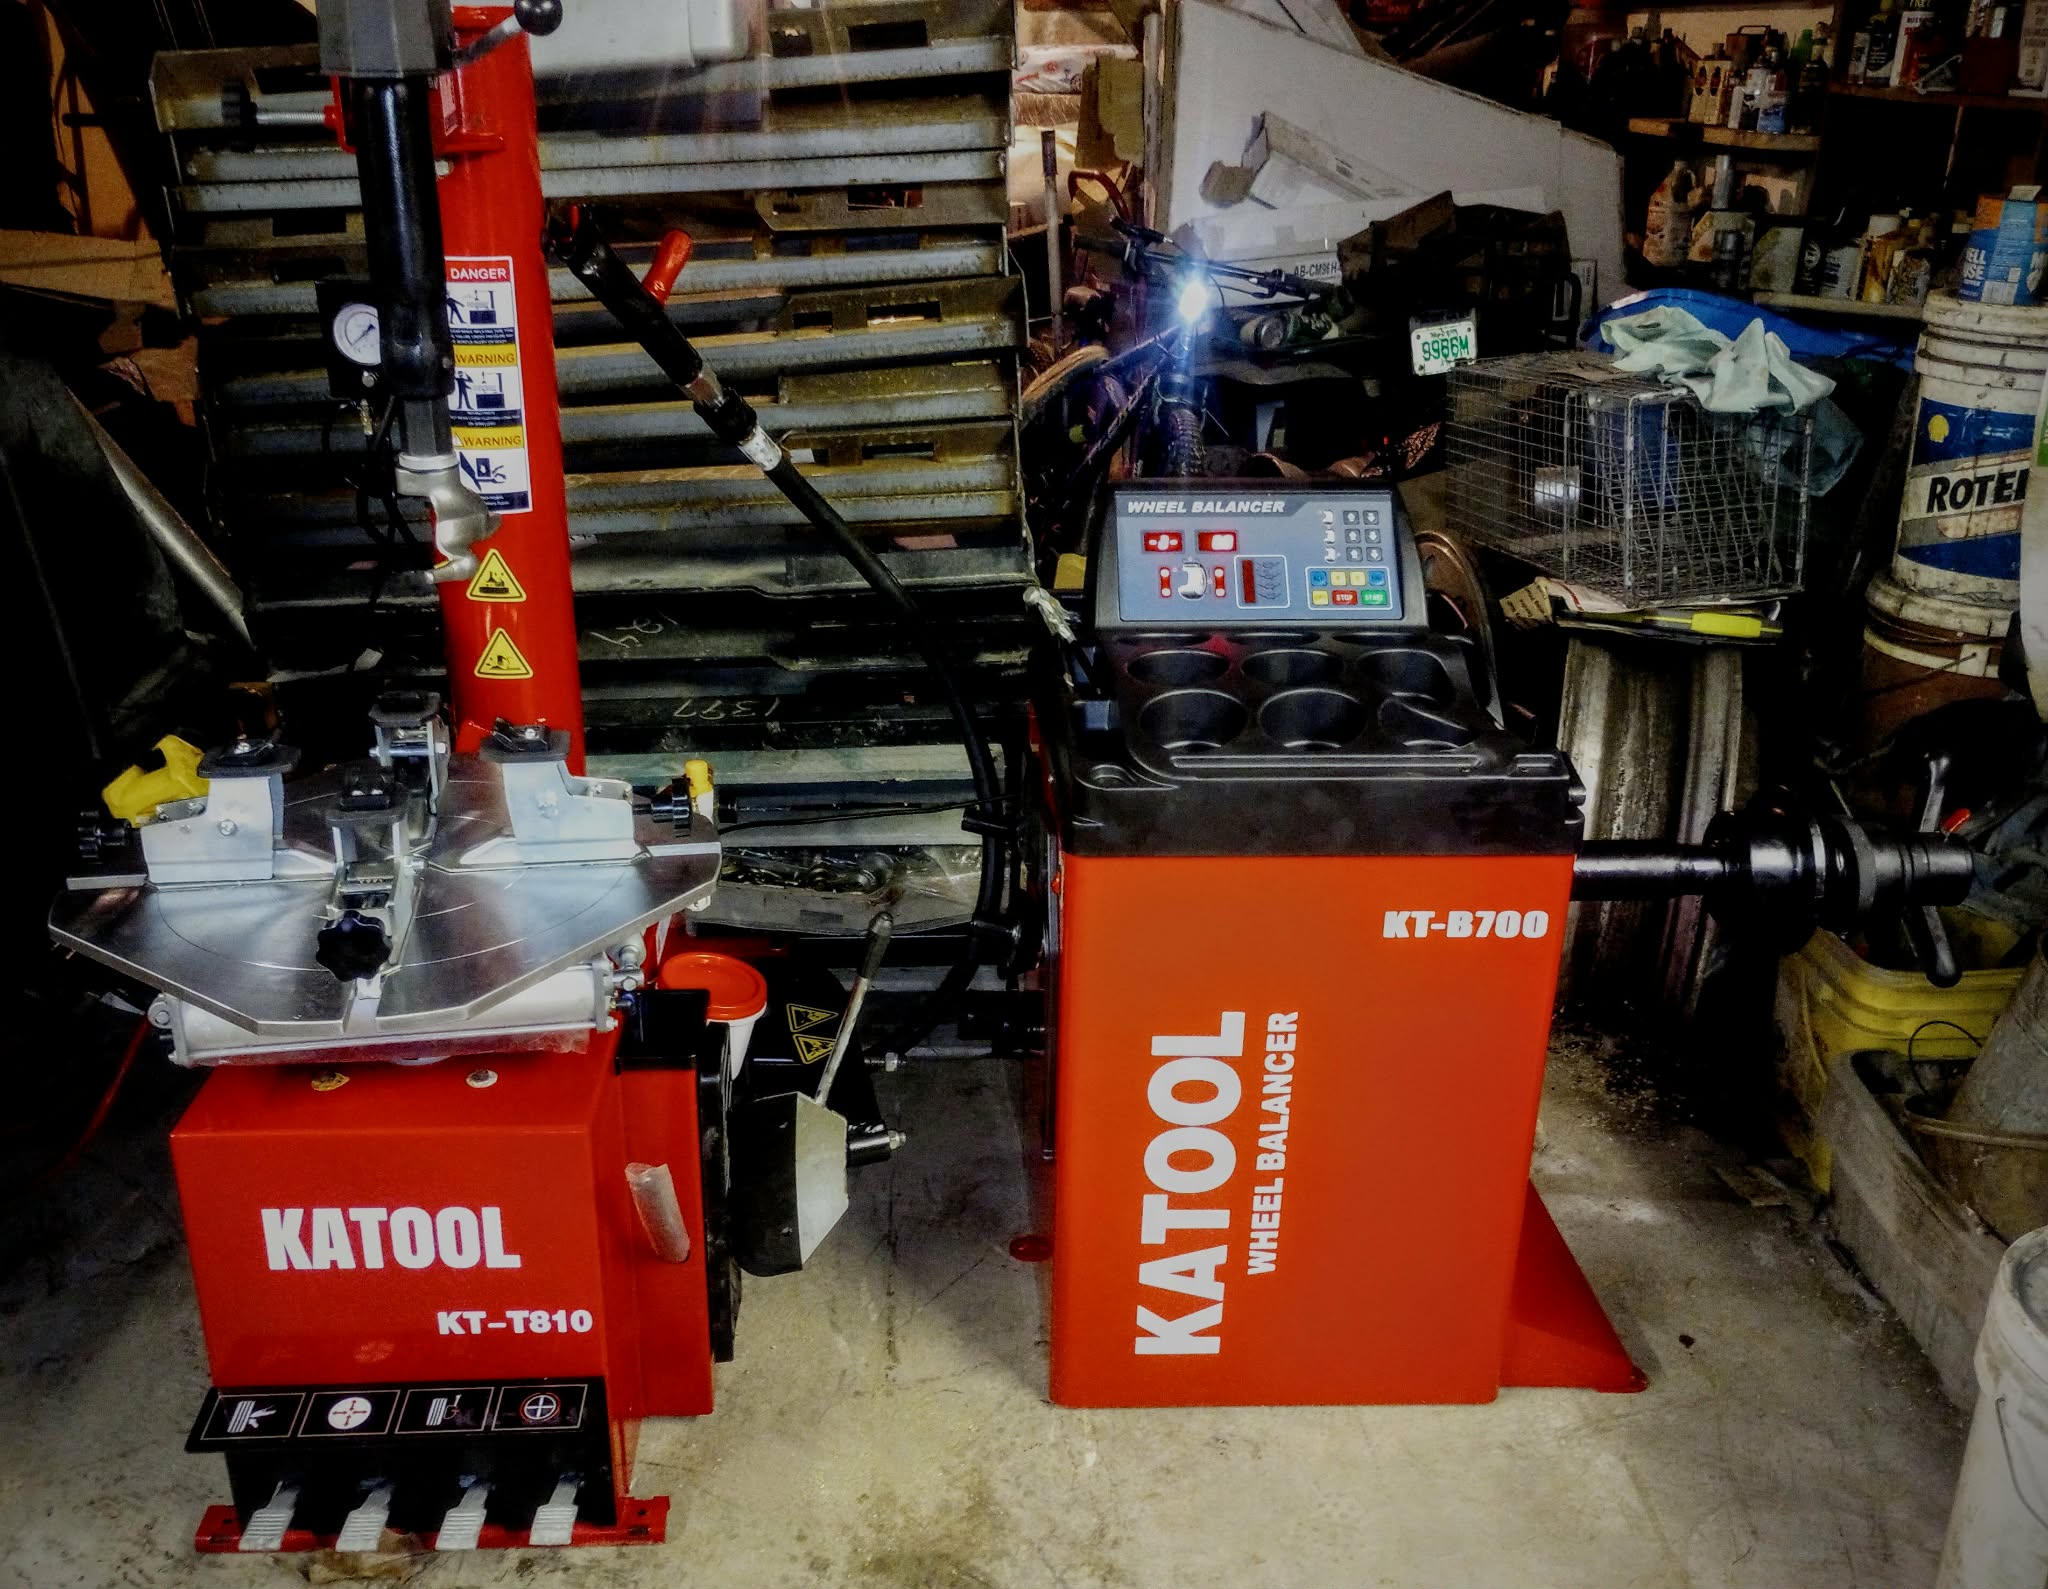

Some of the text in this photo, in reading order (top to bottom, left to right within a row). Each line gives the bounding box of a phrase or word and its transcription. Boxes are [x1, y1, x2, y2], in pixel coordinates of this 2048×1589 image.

[450, 267, 507, 280] DANGER
[455, 353, 515, 364] WARNING
[463, 435, 522, 447] WARNING
[1127, 500, 1285, 514] WHEEL BALANCER
[1335, 593, 1353, 602] STOP
[1382, 910, 1549, 939] KT-B700
[1247, 1011, 1299, 1275] WHEEL BALANCER
[1134, 1011, 1246, 1355] KATOOL
[260, 1205, 522, 1271] KATOOL
[436, 1309, 593, 1335] KT-T810
